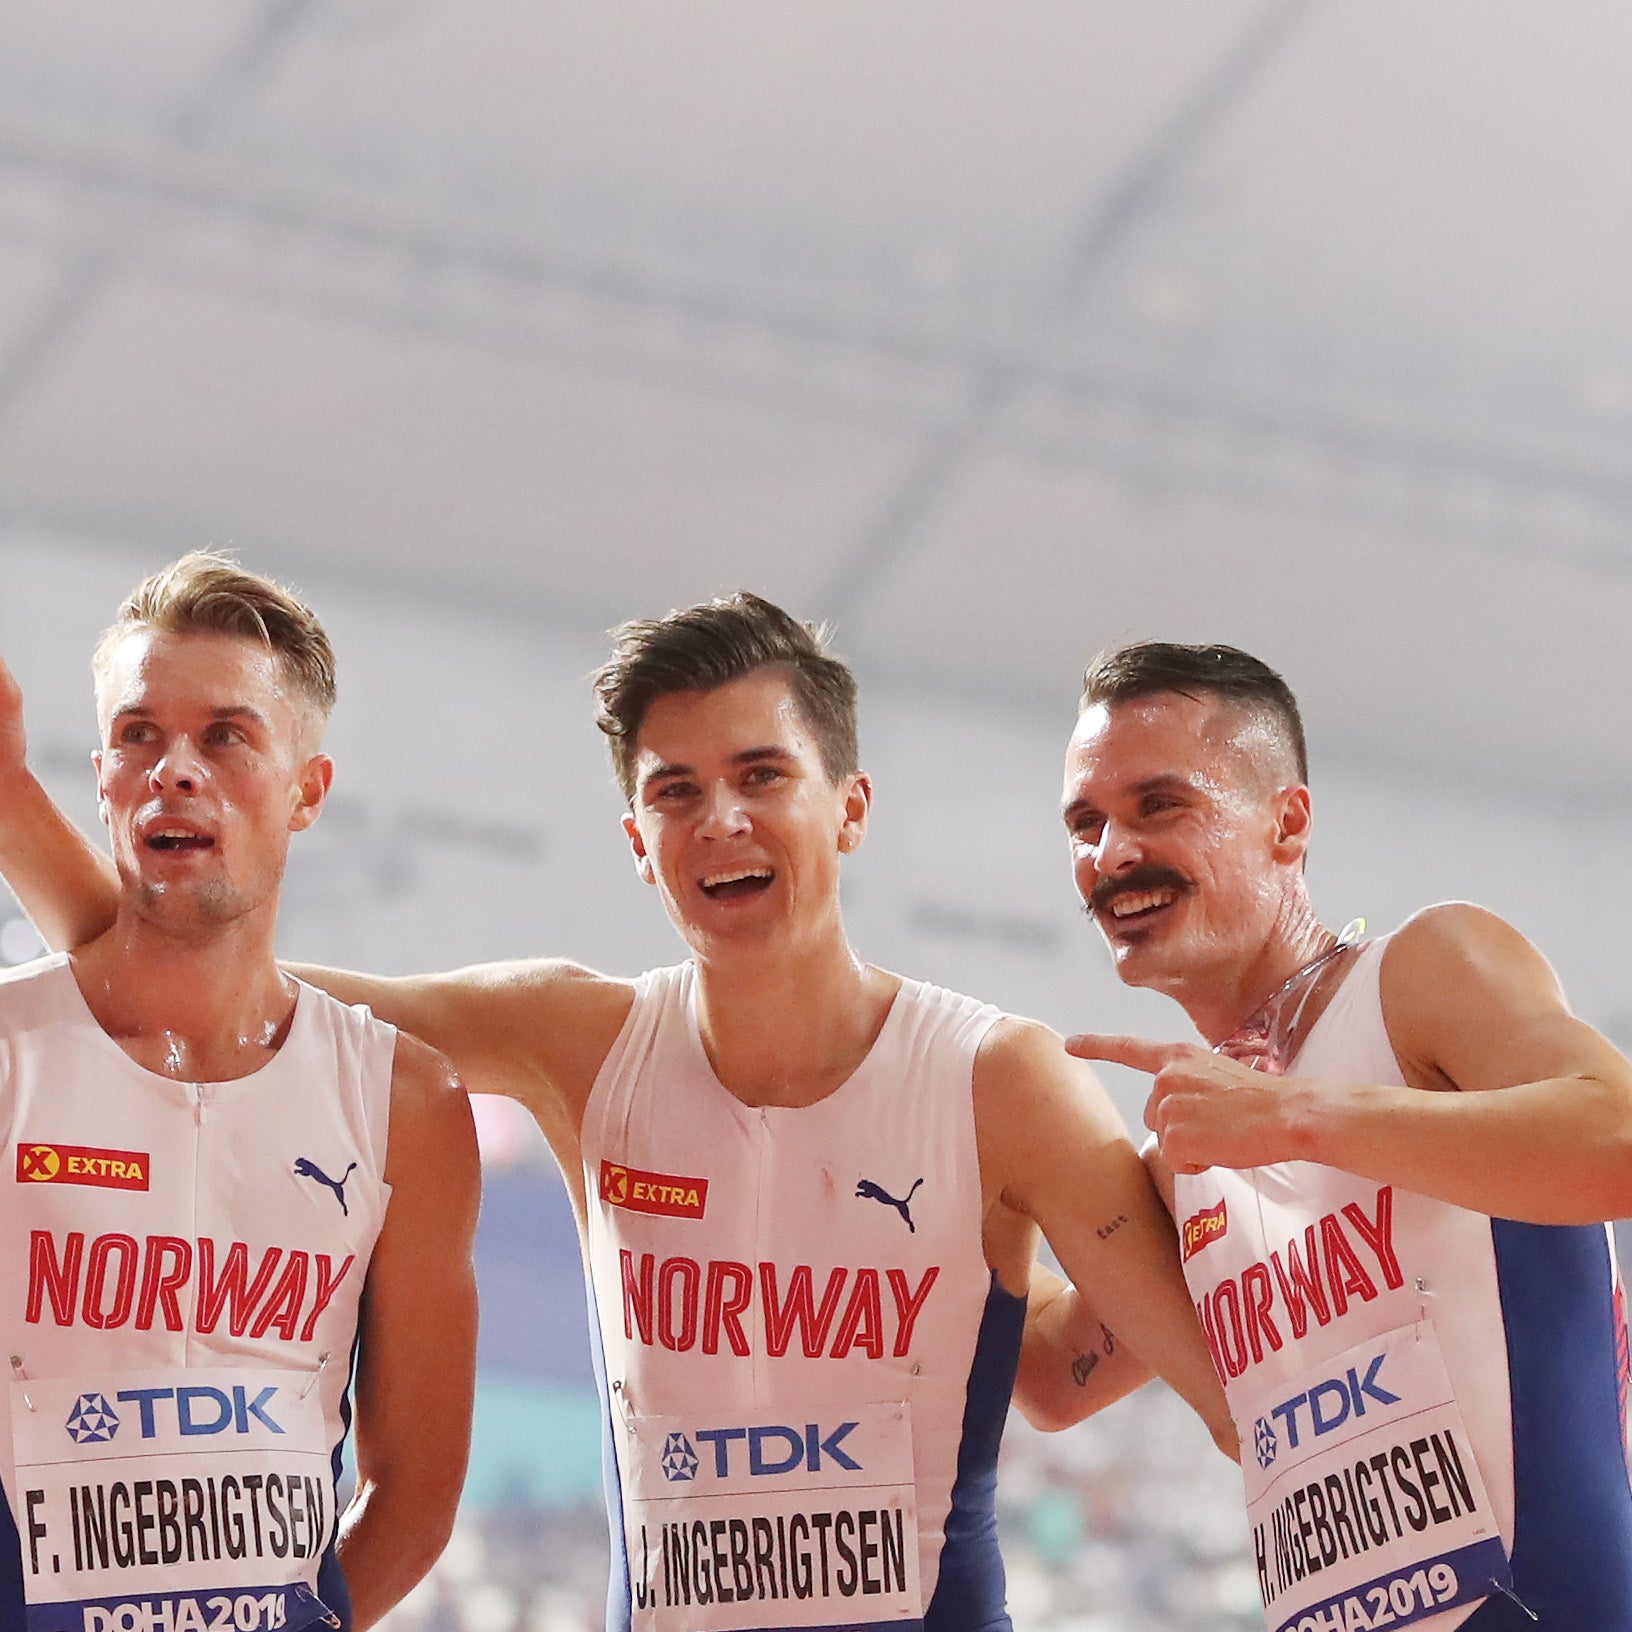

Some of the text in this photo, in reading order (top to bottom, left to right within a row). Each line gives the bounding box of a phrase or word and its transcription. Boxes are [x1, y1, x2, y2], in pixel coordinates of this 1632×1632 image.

[68, 1156, 144, 1180] EXTRA
[633, 1182, 700, 1207] EXTRA
[25, 1230, 355, 1342] NORWAY
[619, 1249, 941, 1360] NORWAY
[117, 1386, 285, 1439] TDK
[695, 1421, 864, 1479] TDK
[1270, 1353, 1402, 1450] TDK
[25, 1473, 324, 1575] F. INGEBRIGTSEN
[636, 1508, 907, 1610] J. INGEBRIGTSEN
[1254, 1429, 1477, 1610] H. INGEBRIGTSEN
